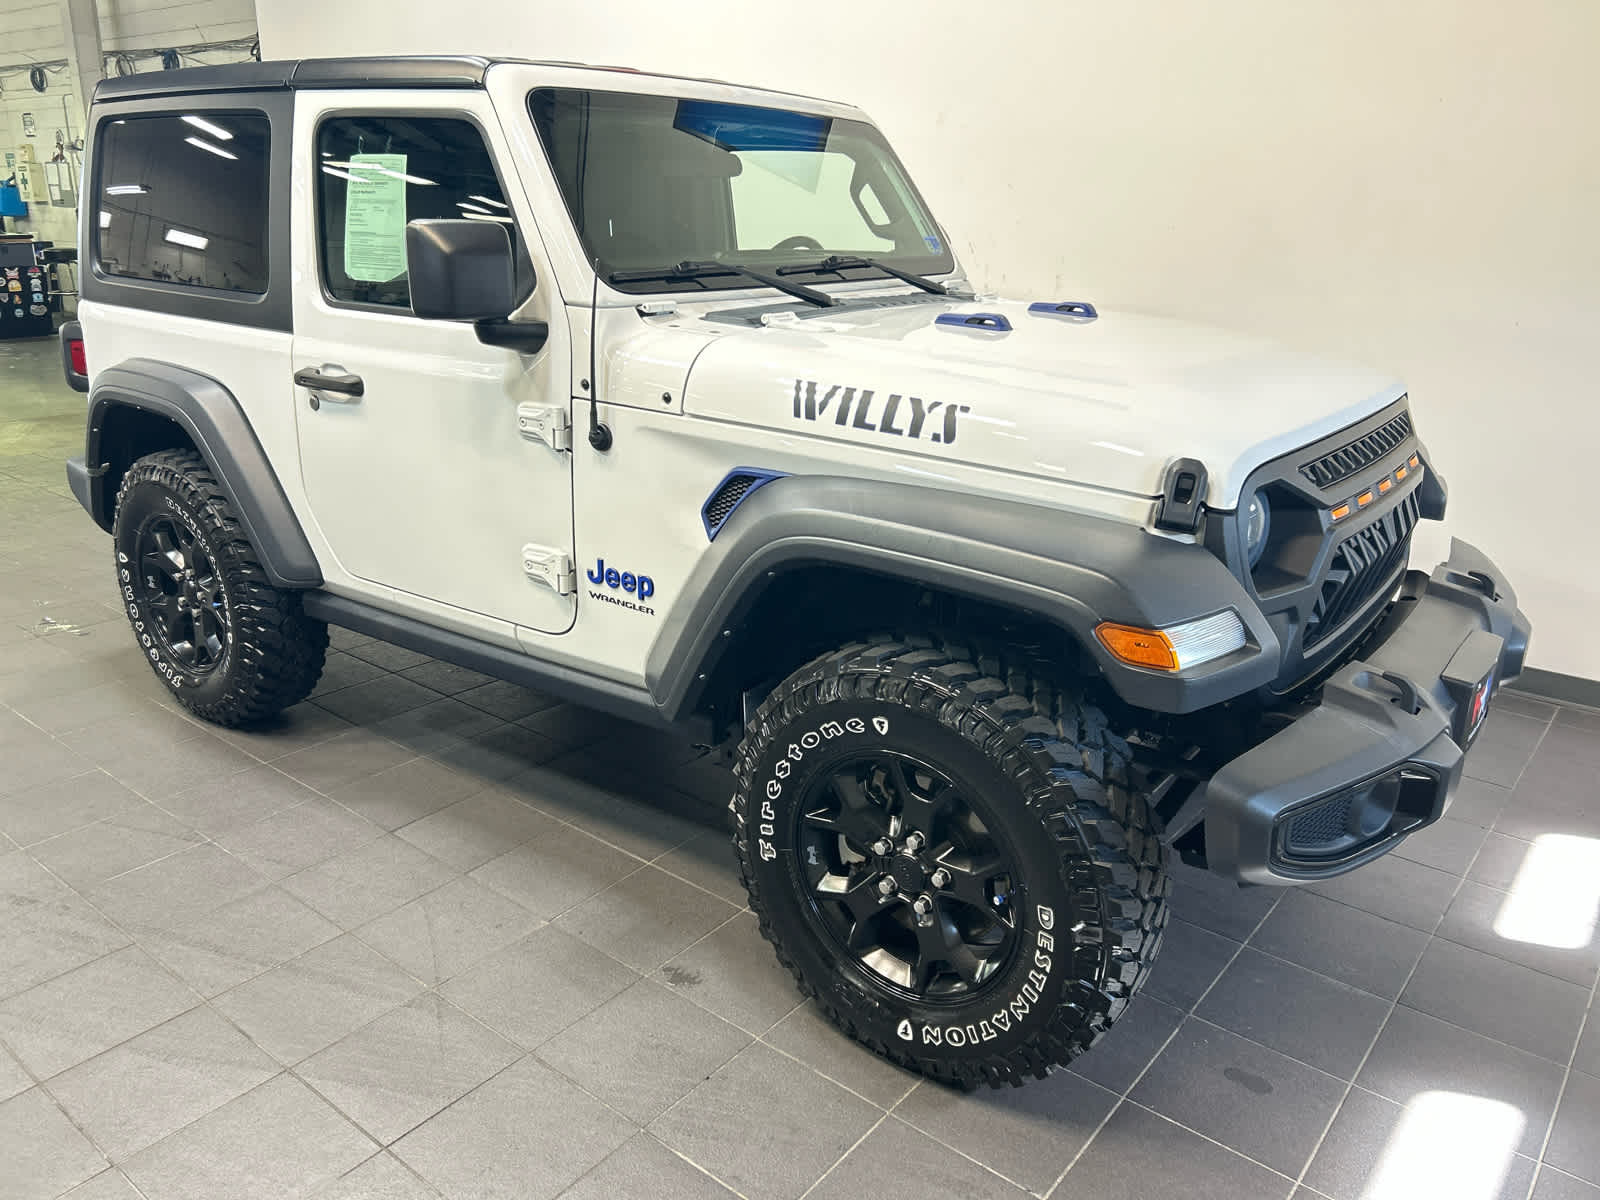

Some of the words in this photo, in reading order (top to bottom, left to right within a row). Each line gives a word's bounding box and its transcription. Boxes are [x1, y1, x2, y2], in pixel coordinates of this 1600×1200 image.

[793, 379, 971, 445] WILLYS
[586, 557, 655, 601] Jeep
[588, 590, 656, 617] WRANGLER
[759, 716, 866, 862] Firestone
[922, 904, 1056, 1048] DESTINATION
